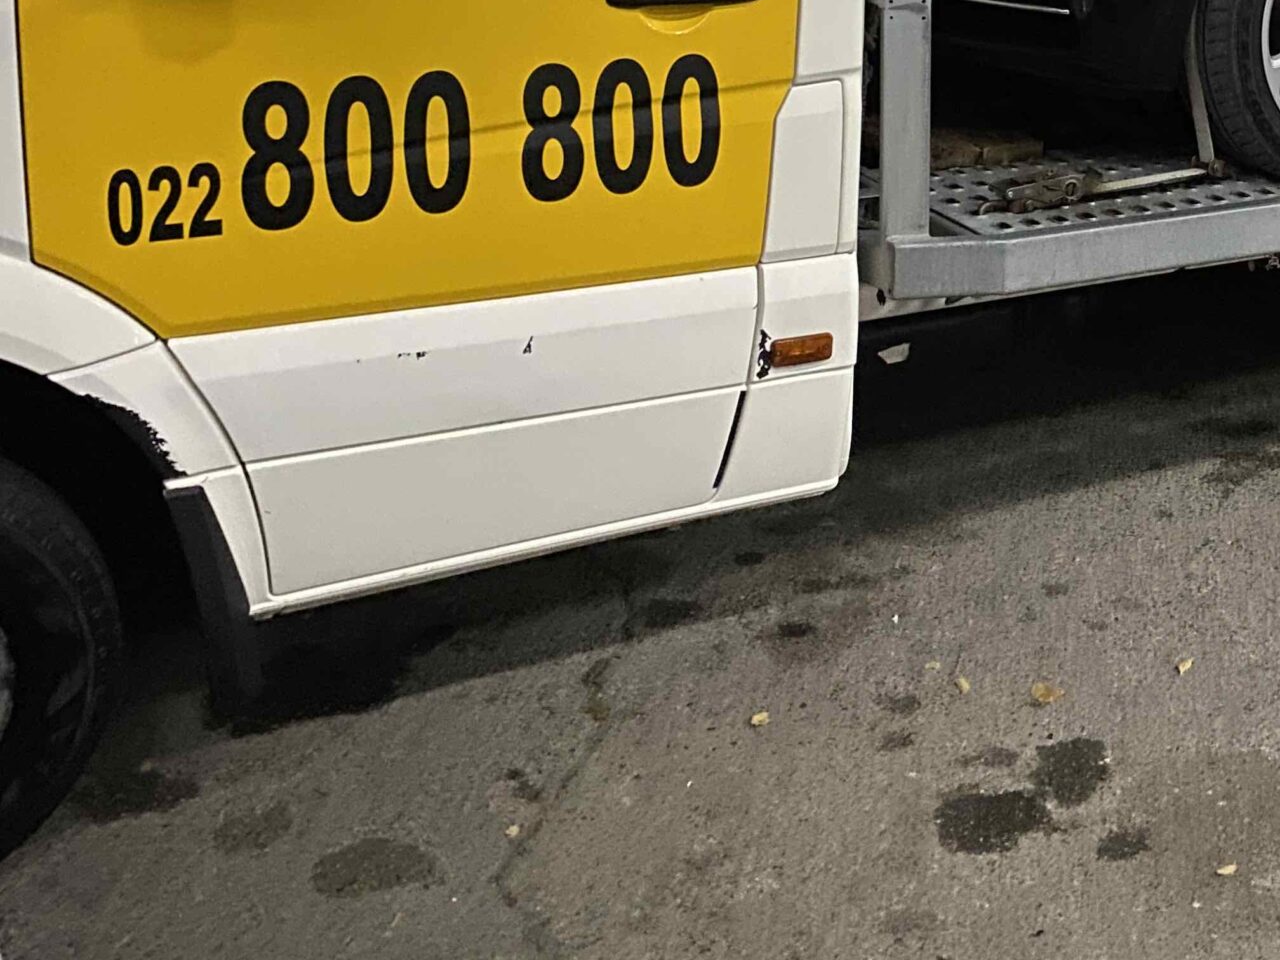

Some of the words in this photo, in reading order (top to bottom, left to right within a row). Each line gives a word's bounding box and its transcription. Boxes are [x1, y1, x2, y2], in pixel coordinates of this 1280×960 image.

[107, 161, 223, 246] 022
[240, 70, 471, 231] 800
[521, 53, 721, 202] 800
